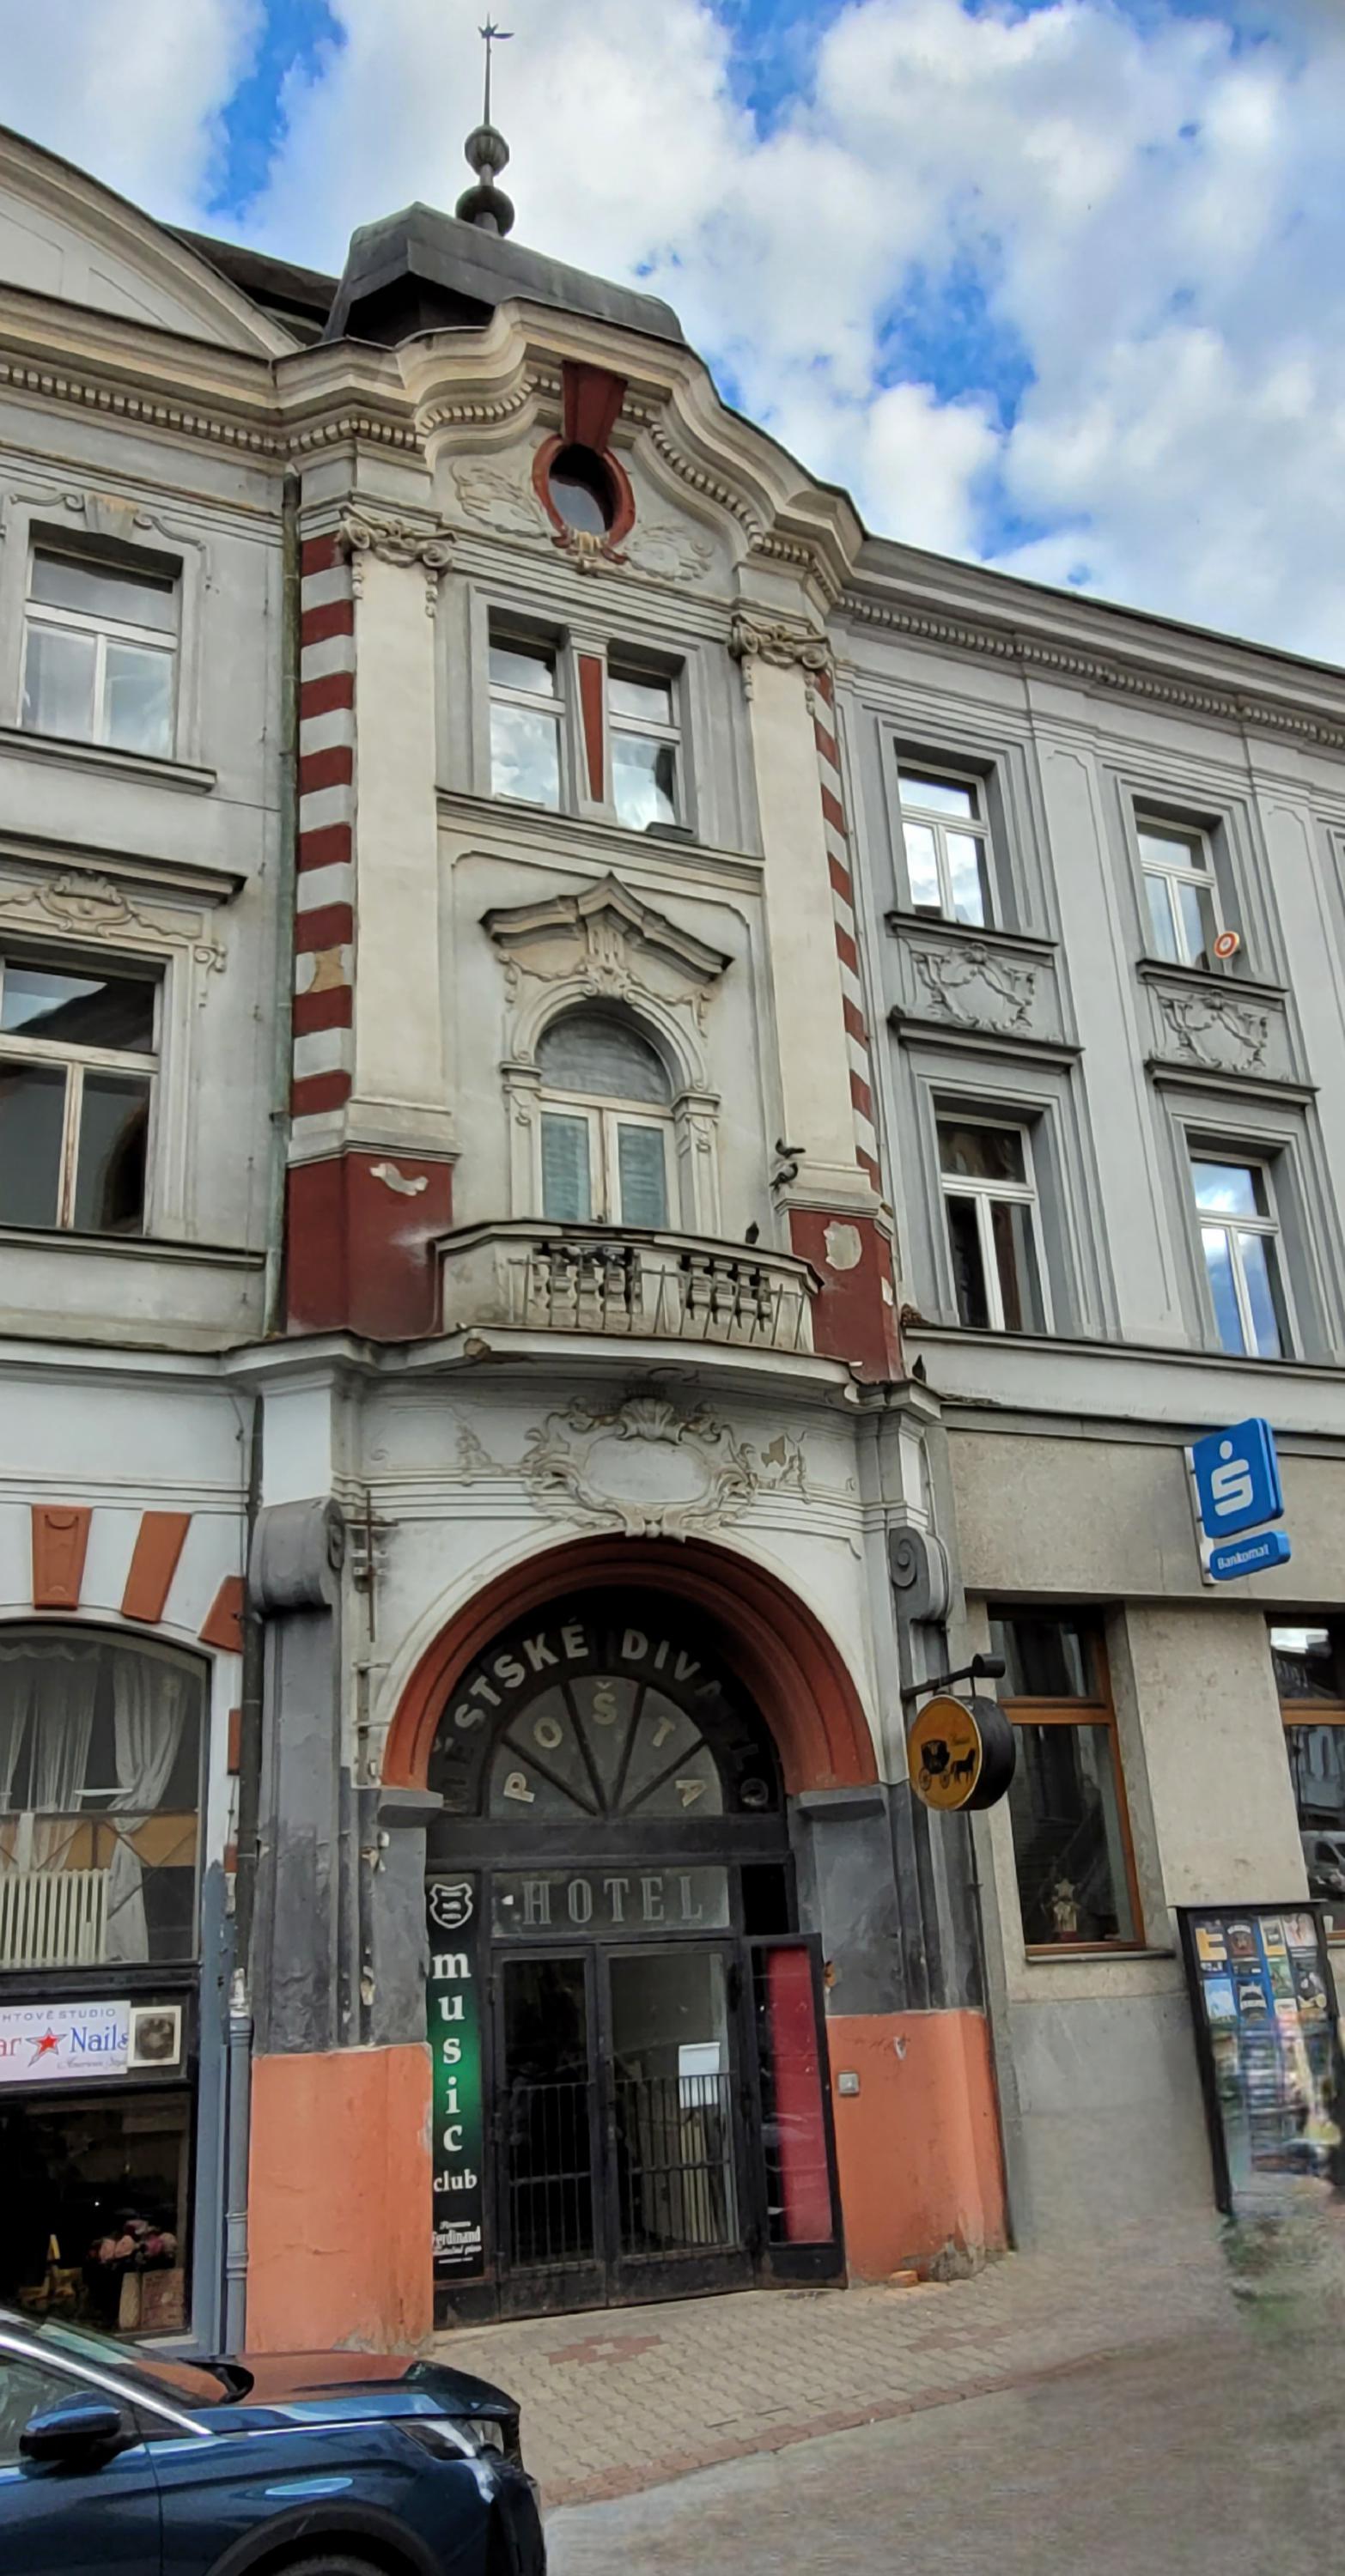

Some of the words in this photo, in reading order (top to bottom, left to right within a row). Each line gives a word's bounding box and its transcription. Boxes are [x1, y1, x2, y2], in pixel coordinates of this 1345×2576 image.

[1217, 1543, 1269, 1570] Bankomat
[621, 1628, 770, 1807] DIVALO
[503, 1681, 707, 1807] POŠTA
[521, 1875, 703, 1925] HOTEL
[58, 2008, 116, 2020] STUDIO
[69, 2025, 129, 2053] Nails
[432, 1952, 472, 2152] music
[433, 2168, 478, 2192] club
